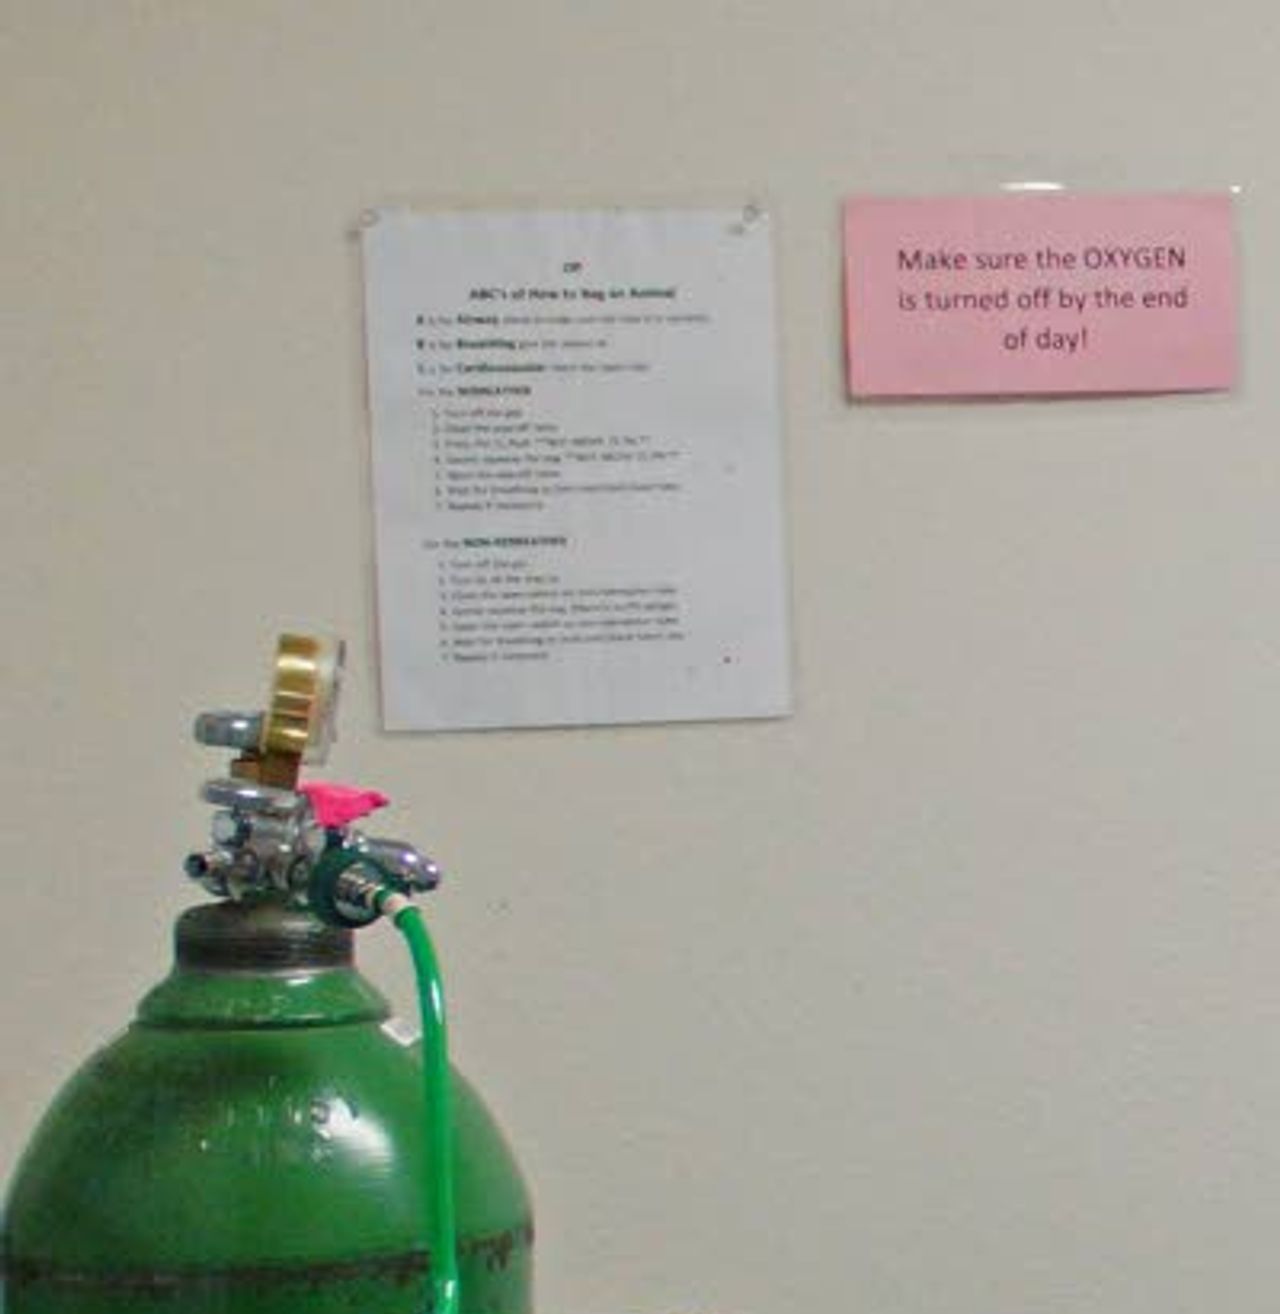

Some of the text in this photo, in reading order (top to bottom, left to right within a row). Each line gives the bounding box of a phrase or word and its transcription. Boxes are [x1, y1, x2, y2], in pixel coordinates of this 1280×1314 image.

[898, 246, 1187, 271] Make sure the OXYGEN
[898, 287, 1189, 314] is turned off by the end
[1003, 327, 1089, 354] of day!
